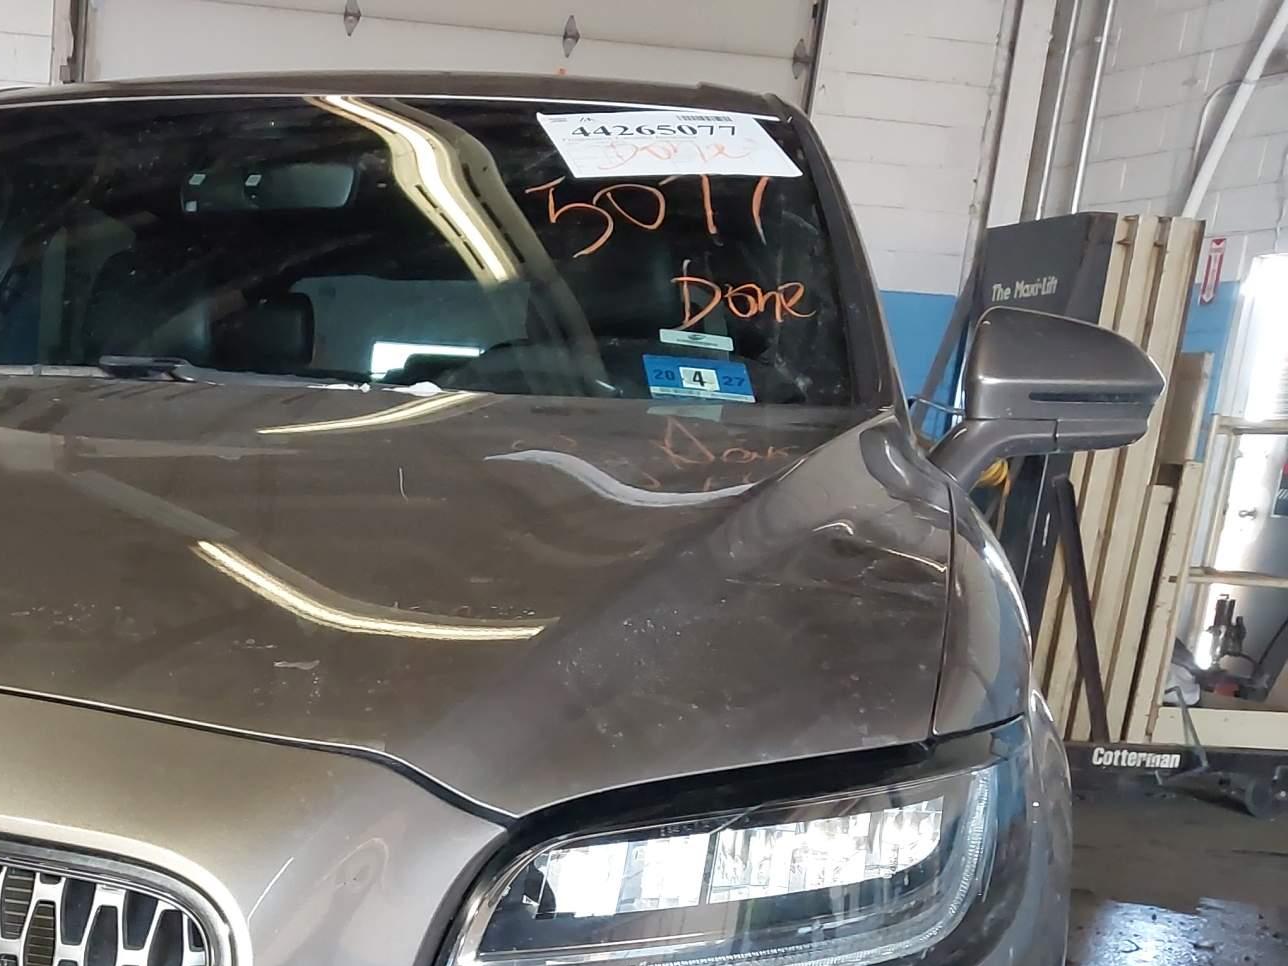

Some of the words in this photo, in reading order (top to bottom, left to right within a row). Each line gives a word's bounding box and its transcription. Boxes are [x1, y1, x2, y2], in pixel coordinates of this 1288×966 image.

[571, 124, 736, 137] 44265077
[991, 282, 1012, 302] The
[652, 368, 676, 381] 20
[692, 370, 706, 387] 4
[721, 375, 745, 387] 27
[1091, 746, 1182, 769] Cotterman
